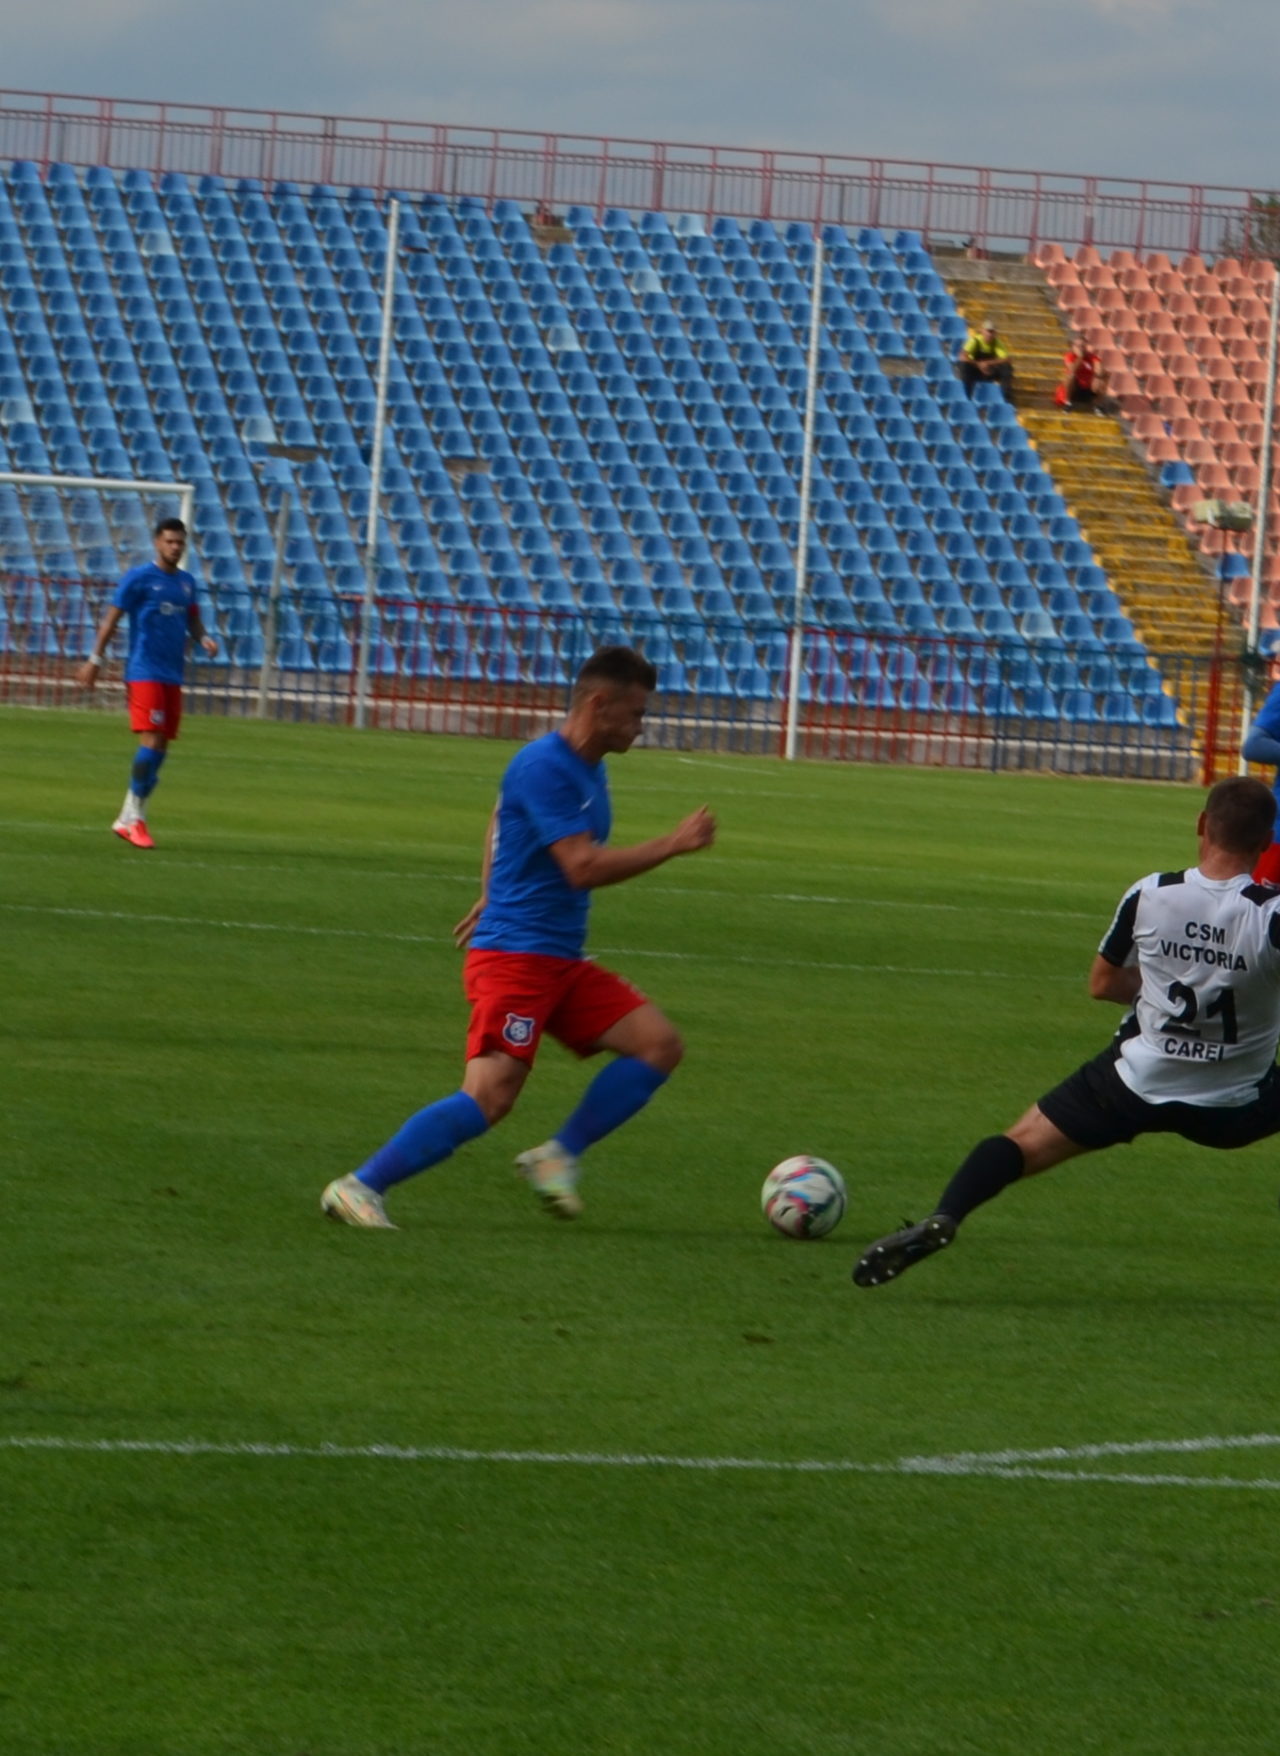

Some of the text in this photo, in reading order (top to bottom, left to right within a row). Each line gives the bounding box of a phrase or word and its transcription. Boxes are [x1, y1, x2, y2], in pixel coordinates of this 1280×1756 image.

[1185, 922, 1225, 944] CSM
[1161, 940, 1248, 971] VICTORIA
[1160, 980, 1238, 1044] 21
[1164, 1038, 1224, 1062] CAREI
